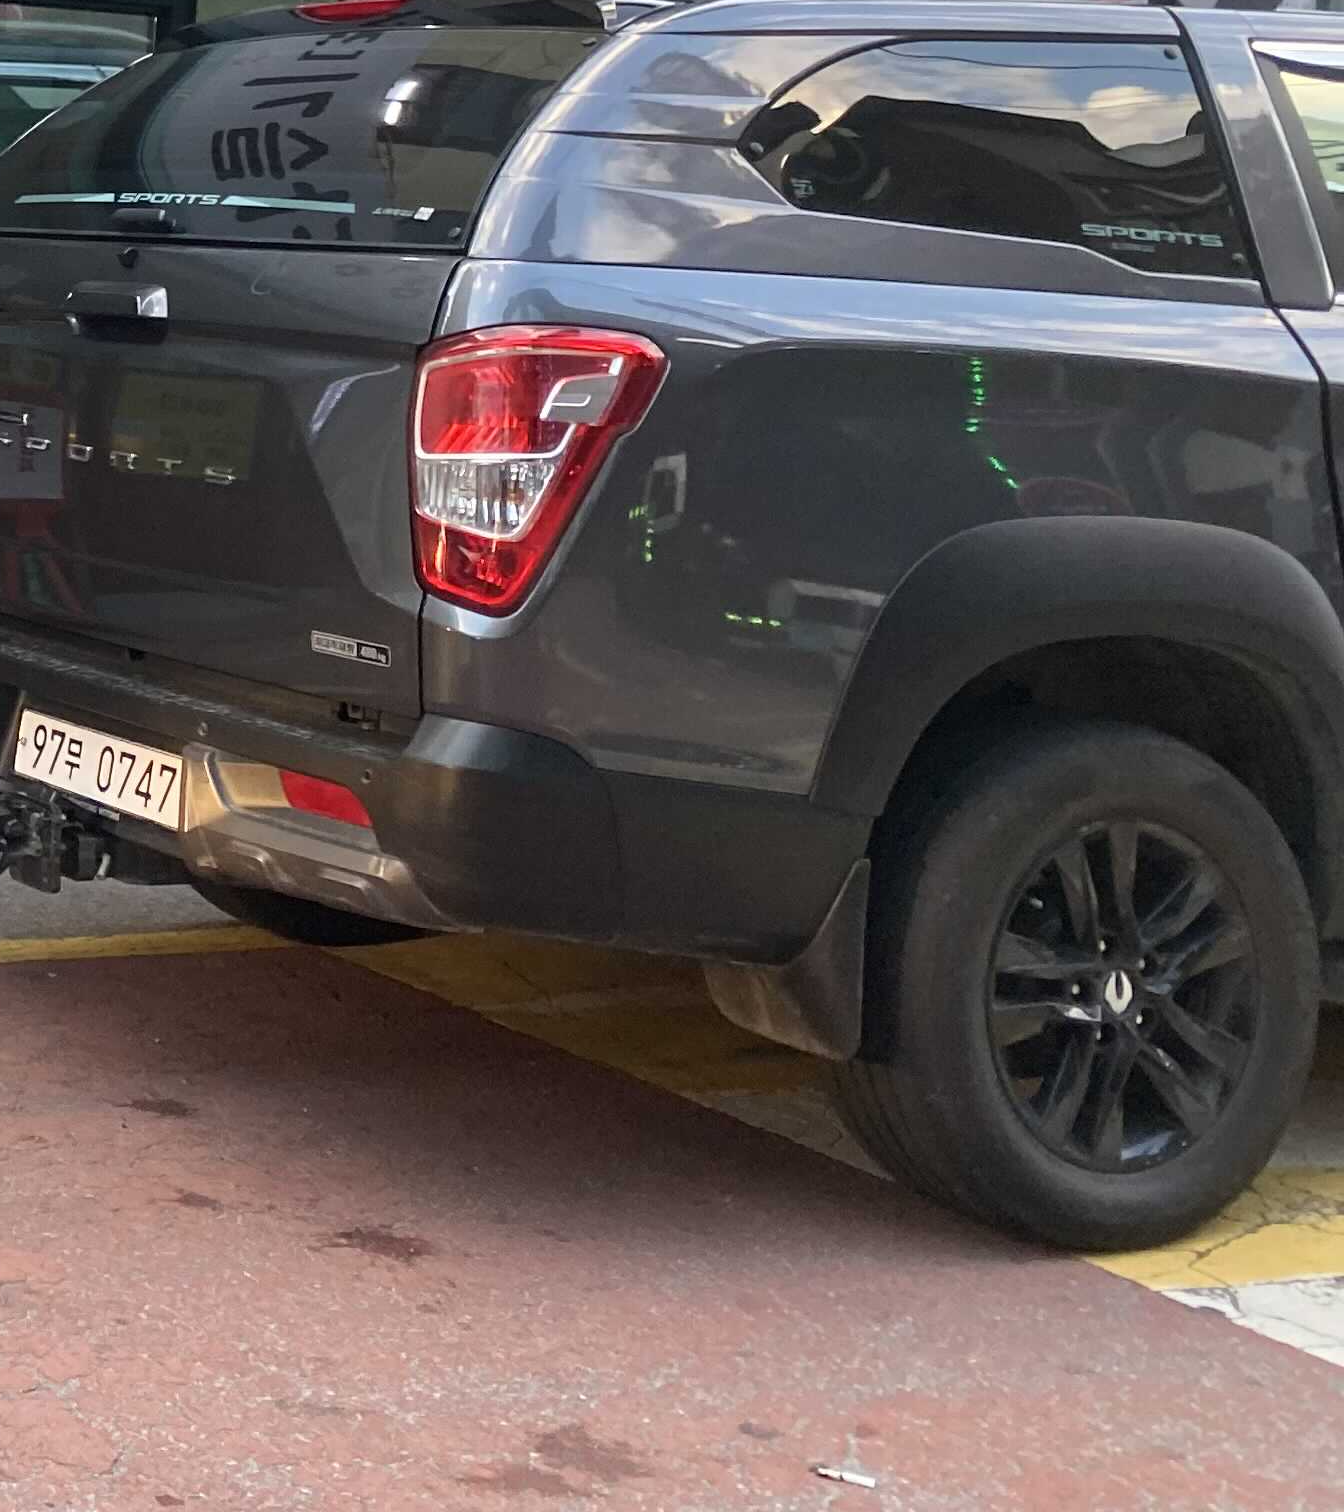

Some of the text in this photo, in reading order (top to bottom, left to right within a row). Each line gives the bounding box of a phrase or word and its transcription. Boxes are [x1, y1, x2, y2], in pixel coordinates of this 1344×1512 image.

[118, 193, 221, 205] SPORTS
[1081, 223, 1224, 248] SPORTS
[33, 724, 177, 813] 97무 0747
